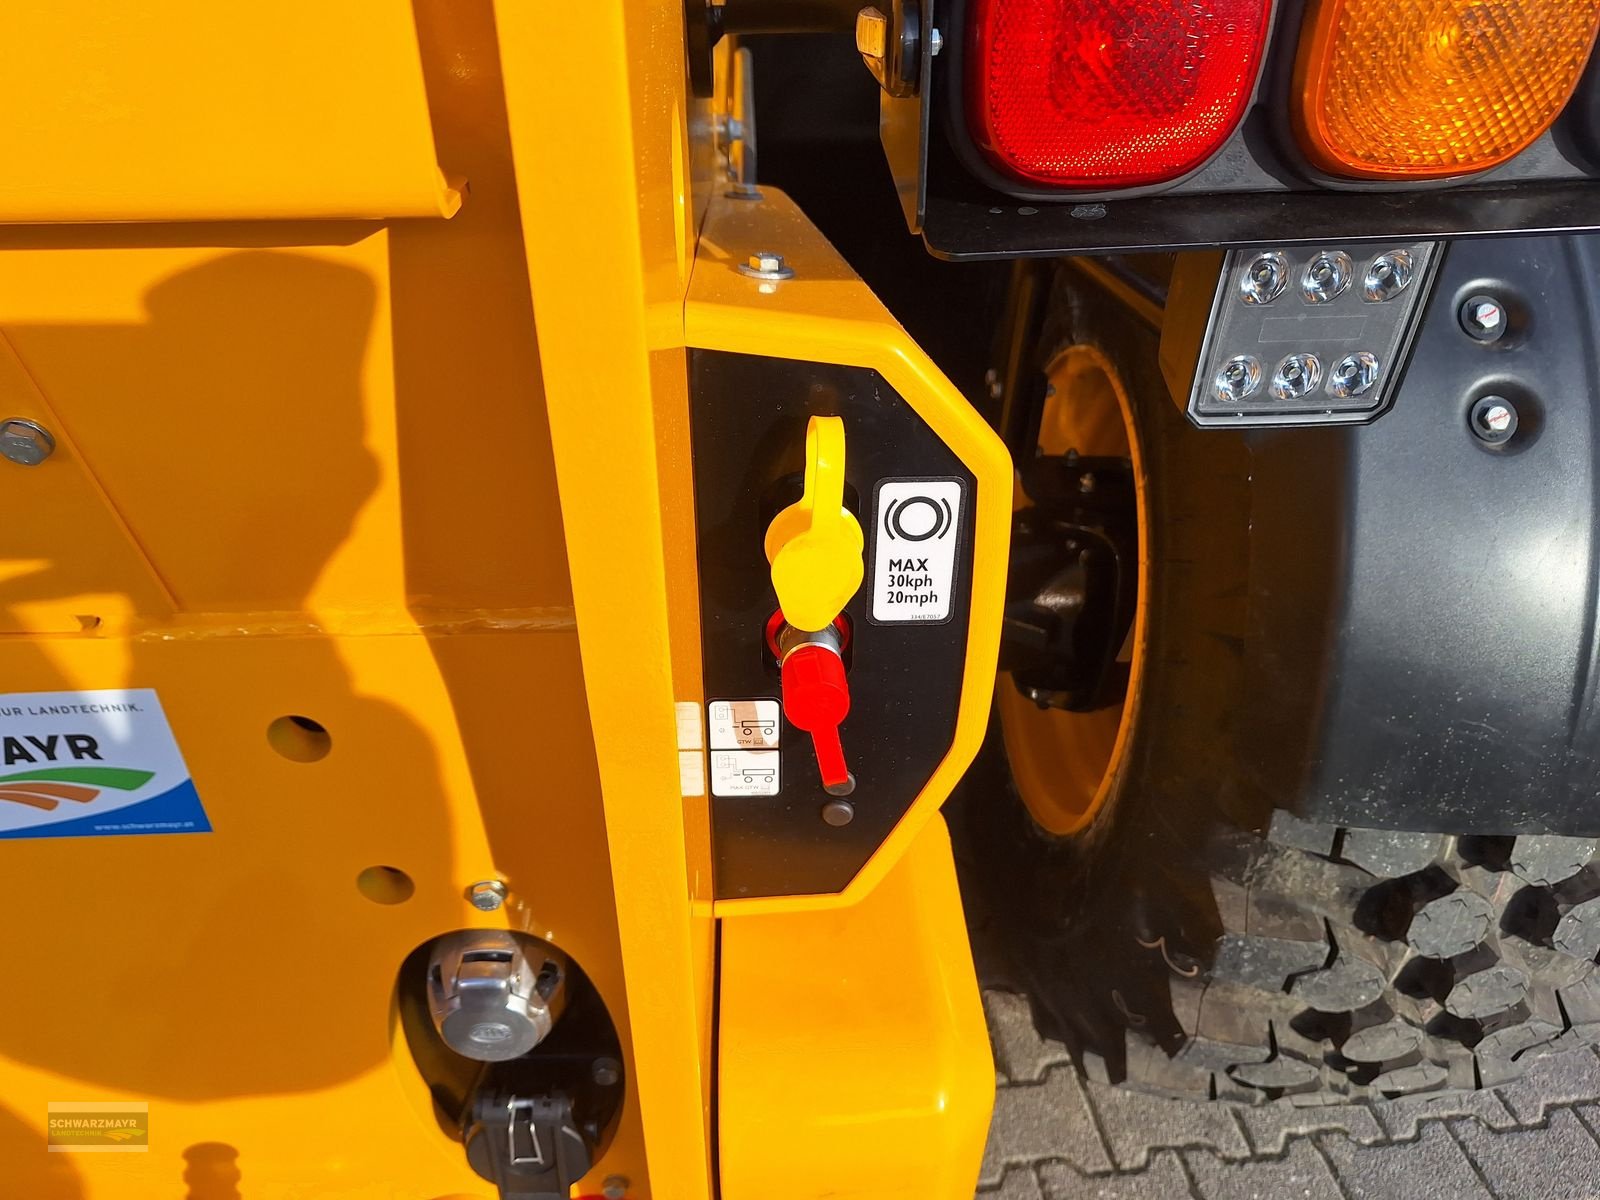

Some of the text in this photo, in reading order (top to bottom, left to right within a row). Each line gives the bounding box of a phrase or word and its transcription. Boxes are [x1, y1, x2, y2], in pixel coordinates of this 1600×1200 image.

[888, 558, 929, 572] MAX
[887, 574, 933, 591] 30kph
[886, 591, 938, 607] 20mph
[0, 703, 144, 717] UR LANDTECHNIK.
[3, 734, 105, 766] AYR
